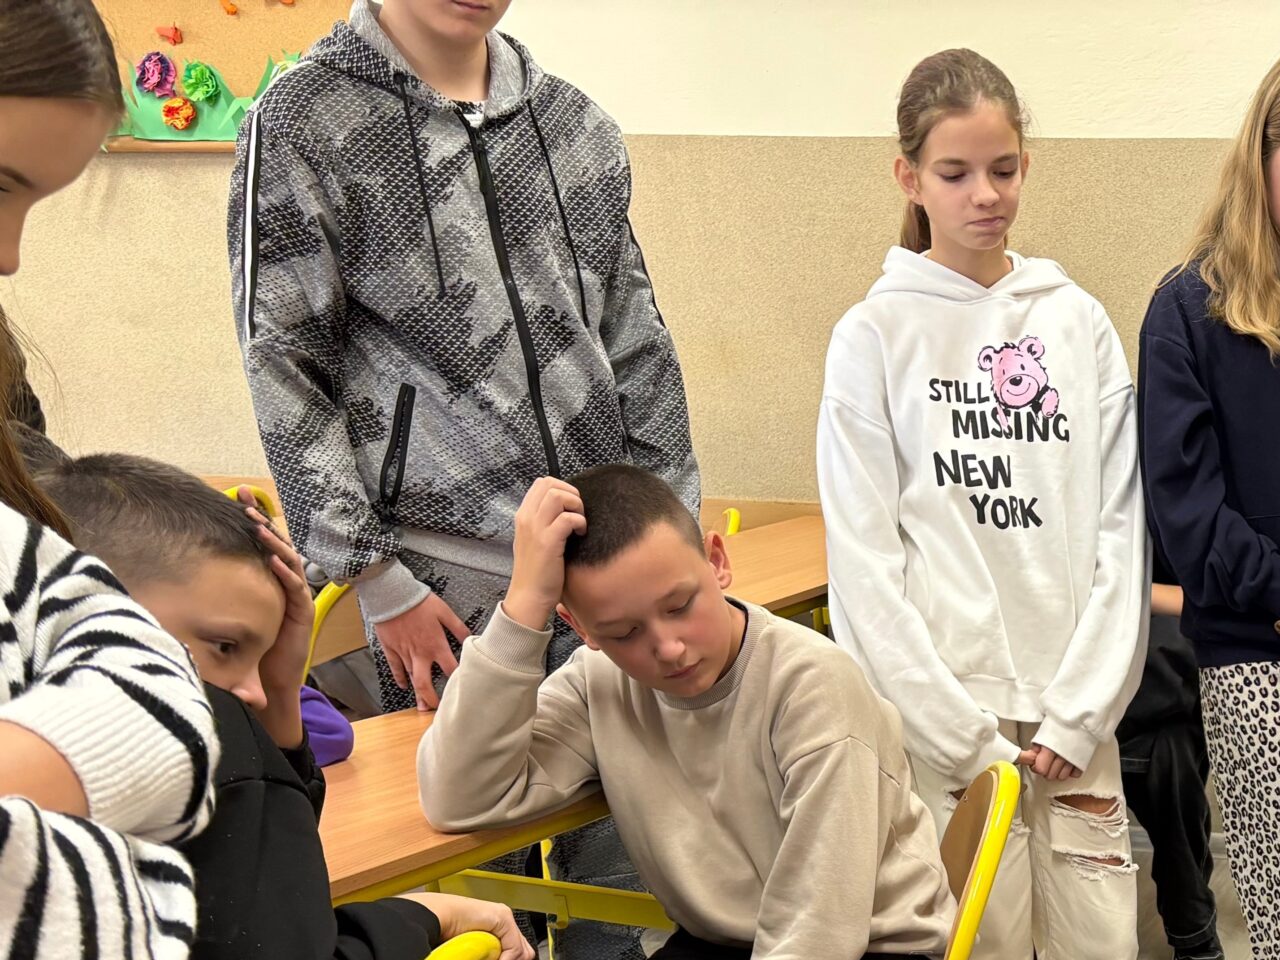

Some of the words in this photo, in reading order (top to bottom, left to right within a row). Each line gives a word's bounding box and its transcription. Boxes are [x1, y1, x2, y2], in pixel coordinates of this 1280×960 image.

[929, 378, 990, 404] STILL
[952, 407, 1070, 442] MISSING
[933, 449, 1012, 490] NEW
[969, 493, 1043, 530] YORK
